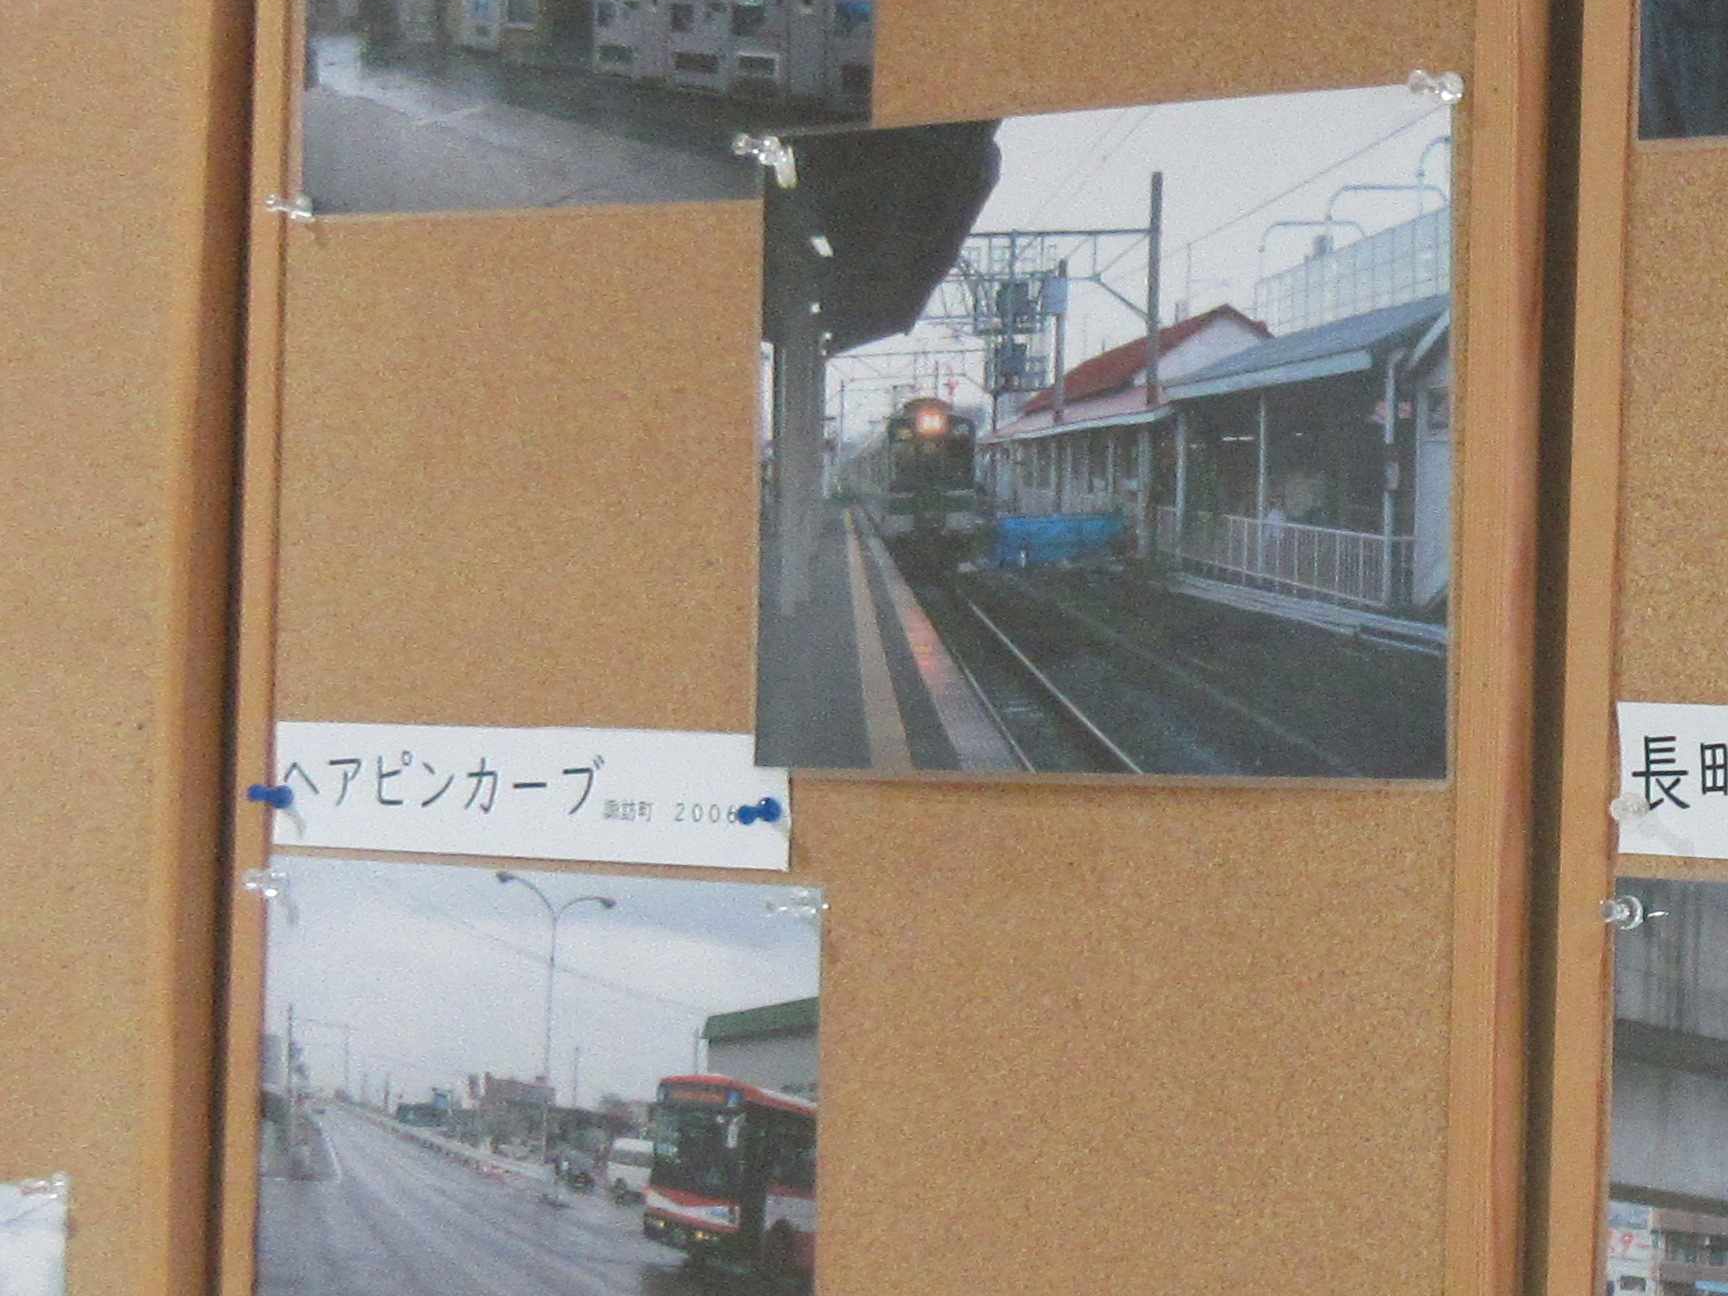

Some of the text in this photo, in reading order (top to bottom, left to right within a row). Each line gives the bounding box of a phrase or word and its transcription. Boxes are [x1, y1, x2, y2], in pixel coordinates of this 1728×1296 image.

[284, 749, 605, 815] ヘアピンカーブ
